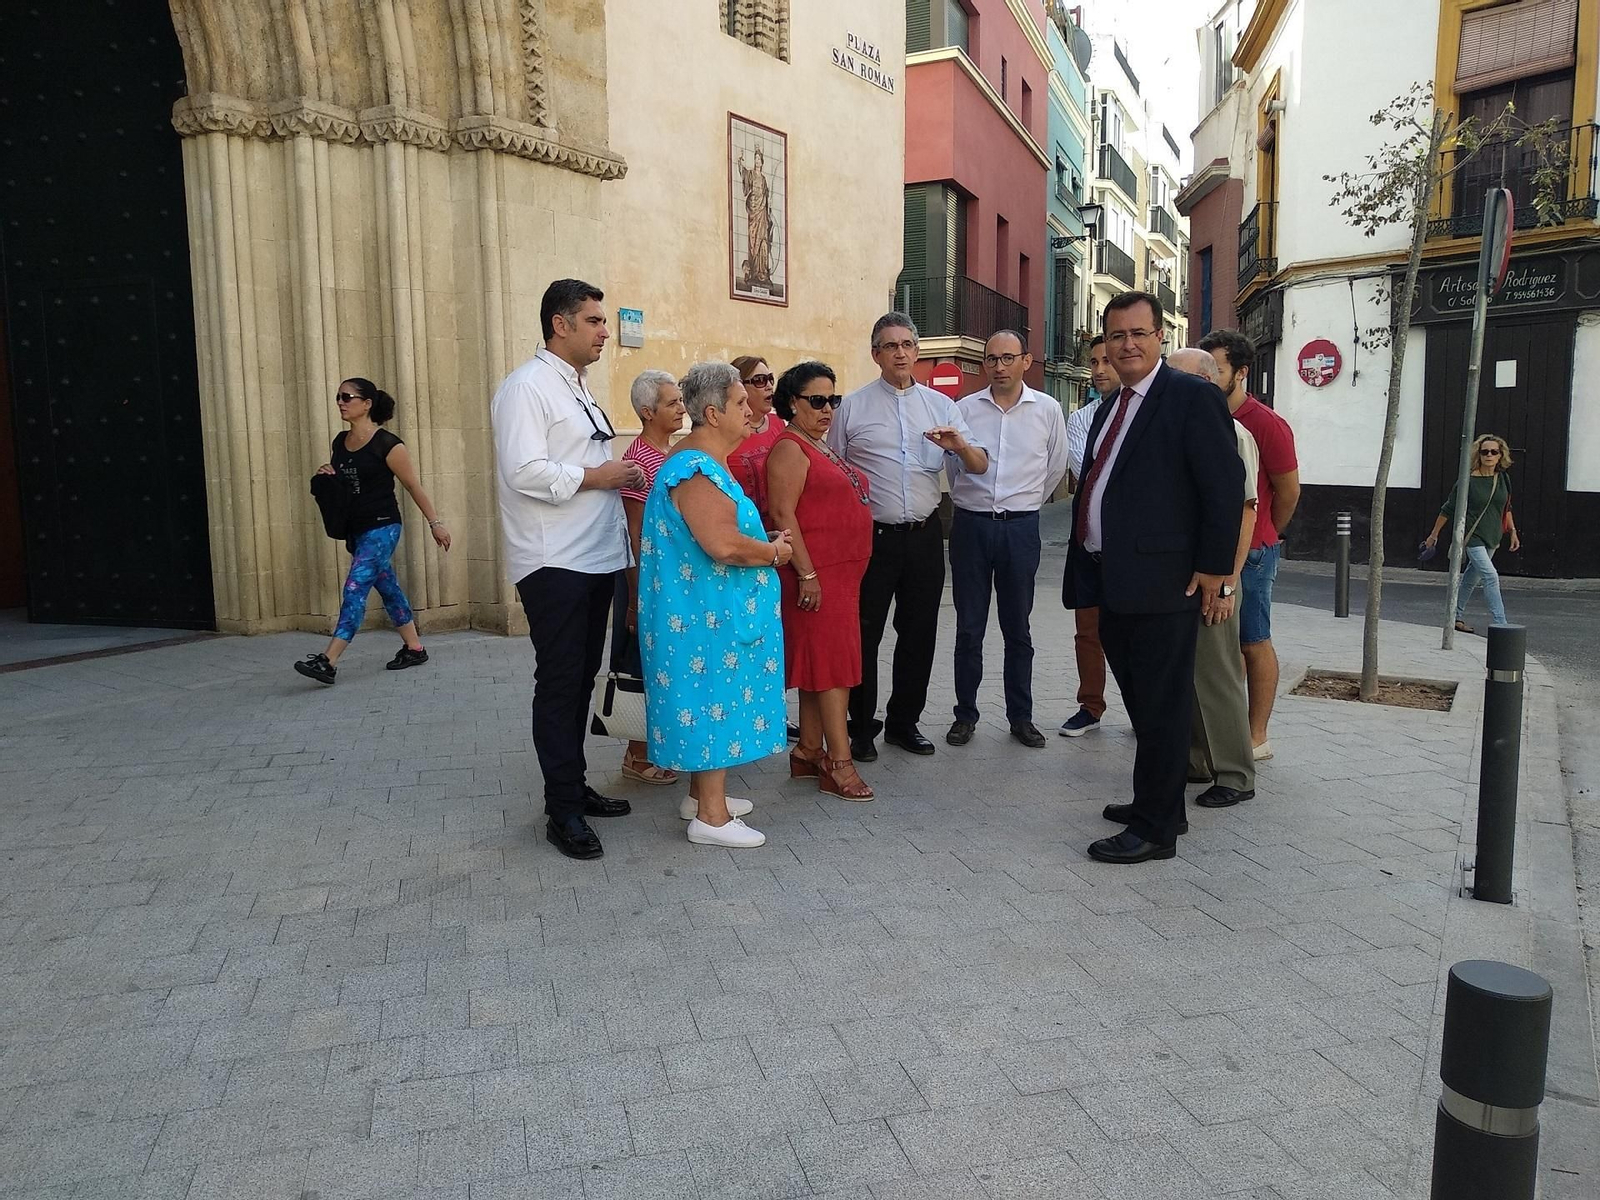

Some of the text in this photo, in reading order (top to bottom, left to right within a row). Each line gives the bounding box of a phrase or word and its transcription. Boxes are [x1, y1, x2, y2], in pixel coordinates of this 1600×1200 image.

[847, 32, 881, 63] PLAZA
[832, 48, 894, 91] SAN ROMAN
